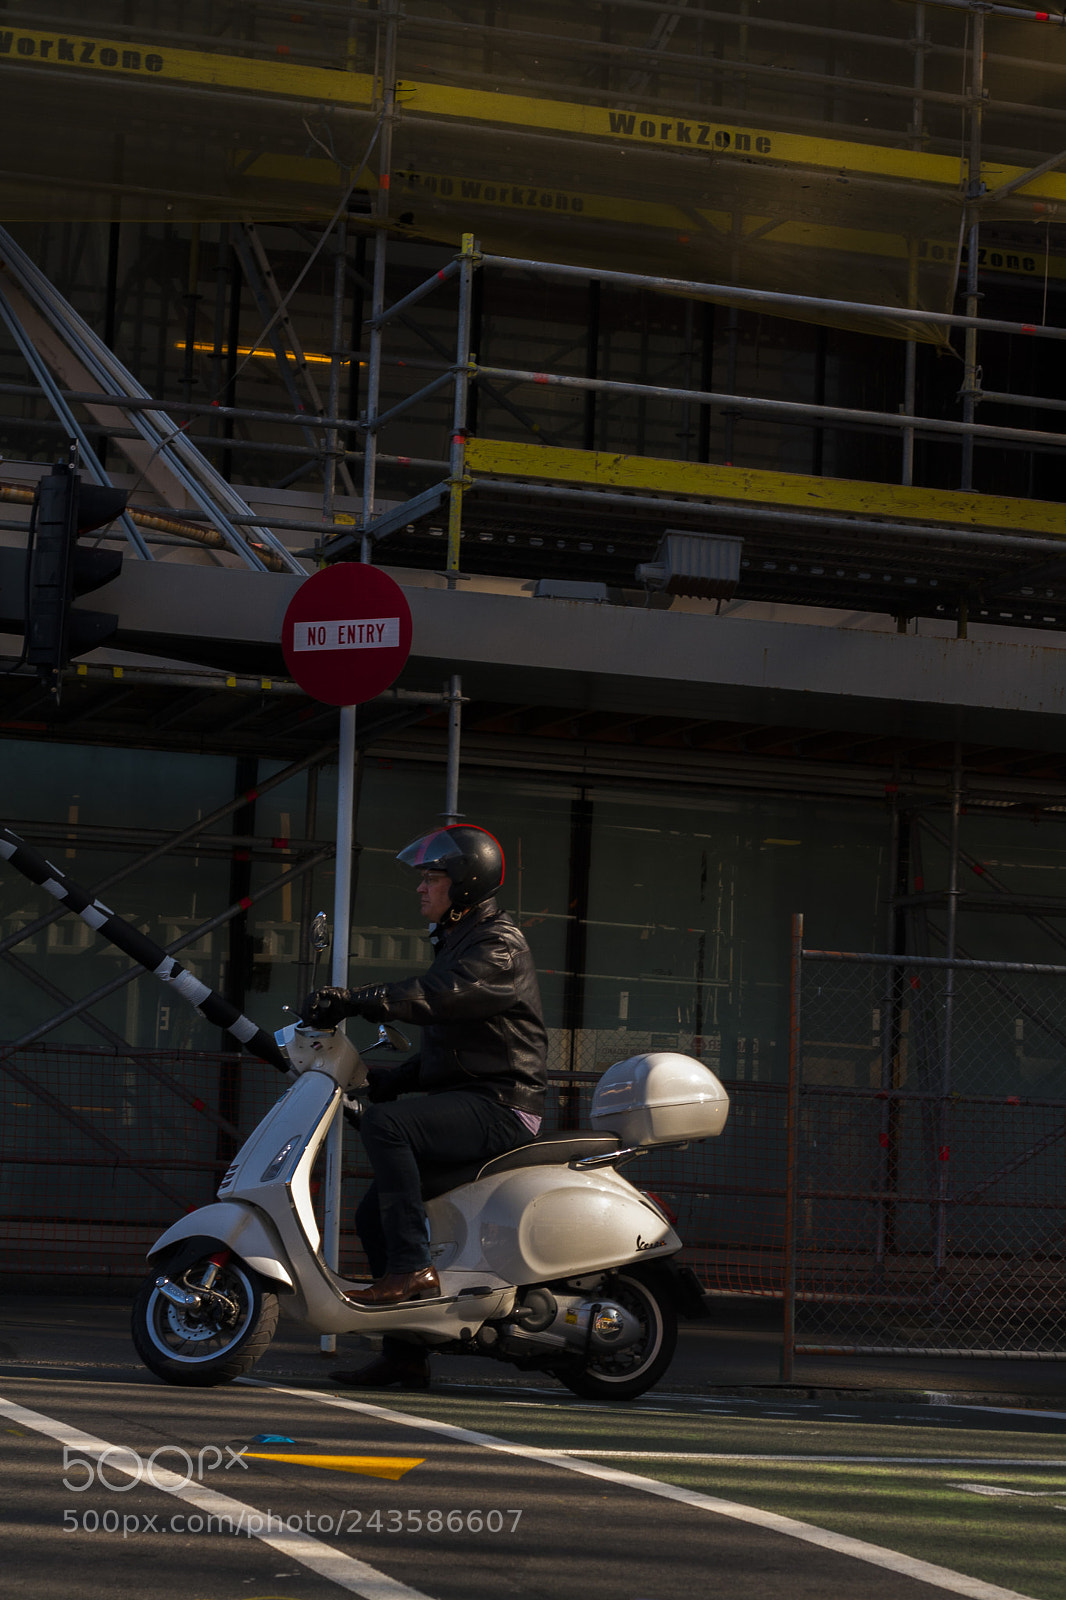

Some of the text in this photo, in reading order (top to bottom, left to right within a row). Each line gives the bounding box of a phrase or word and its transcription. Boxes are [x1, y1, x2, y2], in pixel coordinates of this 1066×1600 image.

[609, 112, 771, 154] WorkZone
[461, 180, 583, 212] WorkZone
[308, 623, 385, 646] NO ENTRY
